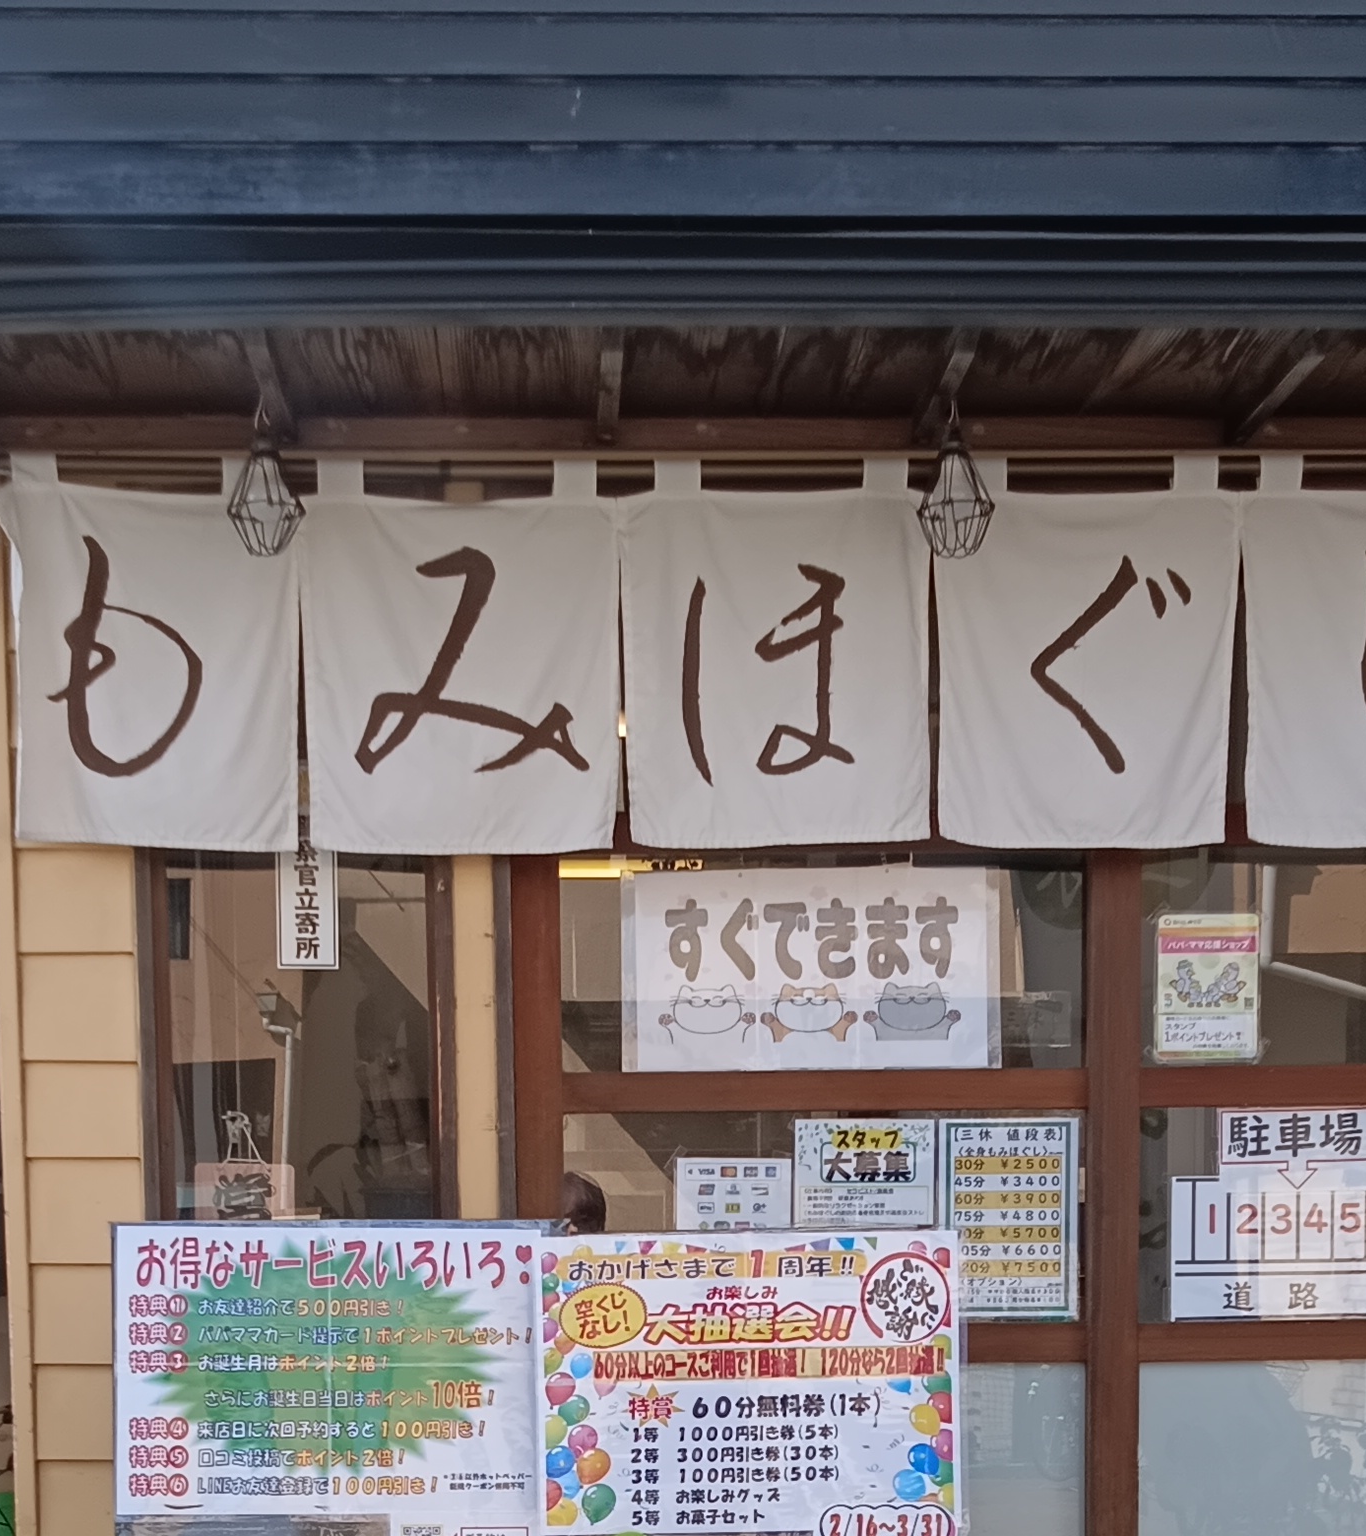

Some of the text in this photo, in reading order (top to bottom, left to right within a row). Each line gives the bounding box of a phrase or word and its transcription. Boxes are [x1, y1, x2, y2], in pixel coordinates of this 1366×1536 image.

[664, 896, 960, 983] すぐできます
[836, 1129, 899, 1149] スタッフ
[1226, 1112, 1363, 1159] 駐車場
[697, 1168, 716, 1176] VISA
[823, 1150, 912, 1182] 大募集
[954, 1158, 986, 1171] 30分
[954, 1175, 986, 1188] 45分
[954, 1193, 985, 1205] 60分
[954, 1210, 985, 1223] 75分
[1208, 1203, 1217, 1235] 1
[1235, 1203, 1260, 1235] 2
[1269, 1203, 1294, 1235] 3
[1302, 1202, 1330, 1234] 4
[1339, 1202, 1362, 1234] 5
[961, 1245, 992, 1257] 05分
[961, 1262, 991, 1274] 20分
[705, 1285, 779, 1301] お楽しみ
[129, 1294, 189, 1318] 特典①
[574, 1289, 627, 1322] 空くじ
[129, 1321, 189, 1346] 特典②
[578, 1309, 631, 1341] なし!
[642, 1301, 857, 1347] 大抽選会!!
[129, 1350, 189, 1374] 特典③
[628, 1395, 674, 1420] 特賞
[129, 1416, 190, 1441] 特典④
[632, 1427, 660, 1444] 1等
[129, 1445, 190, 1469] 特典⑤
[630, 1447, 660, 1464] 2等
[129, 1473, 190, 1497] 特典⑥
[631, 1468, 660, 1485] 3等
[630, 1486, 781, 1506] 4等 お楽しみグッズ
[631, 1507, 766, 1527] 5等 お菓子セット
